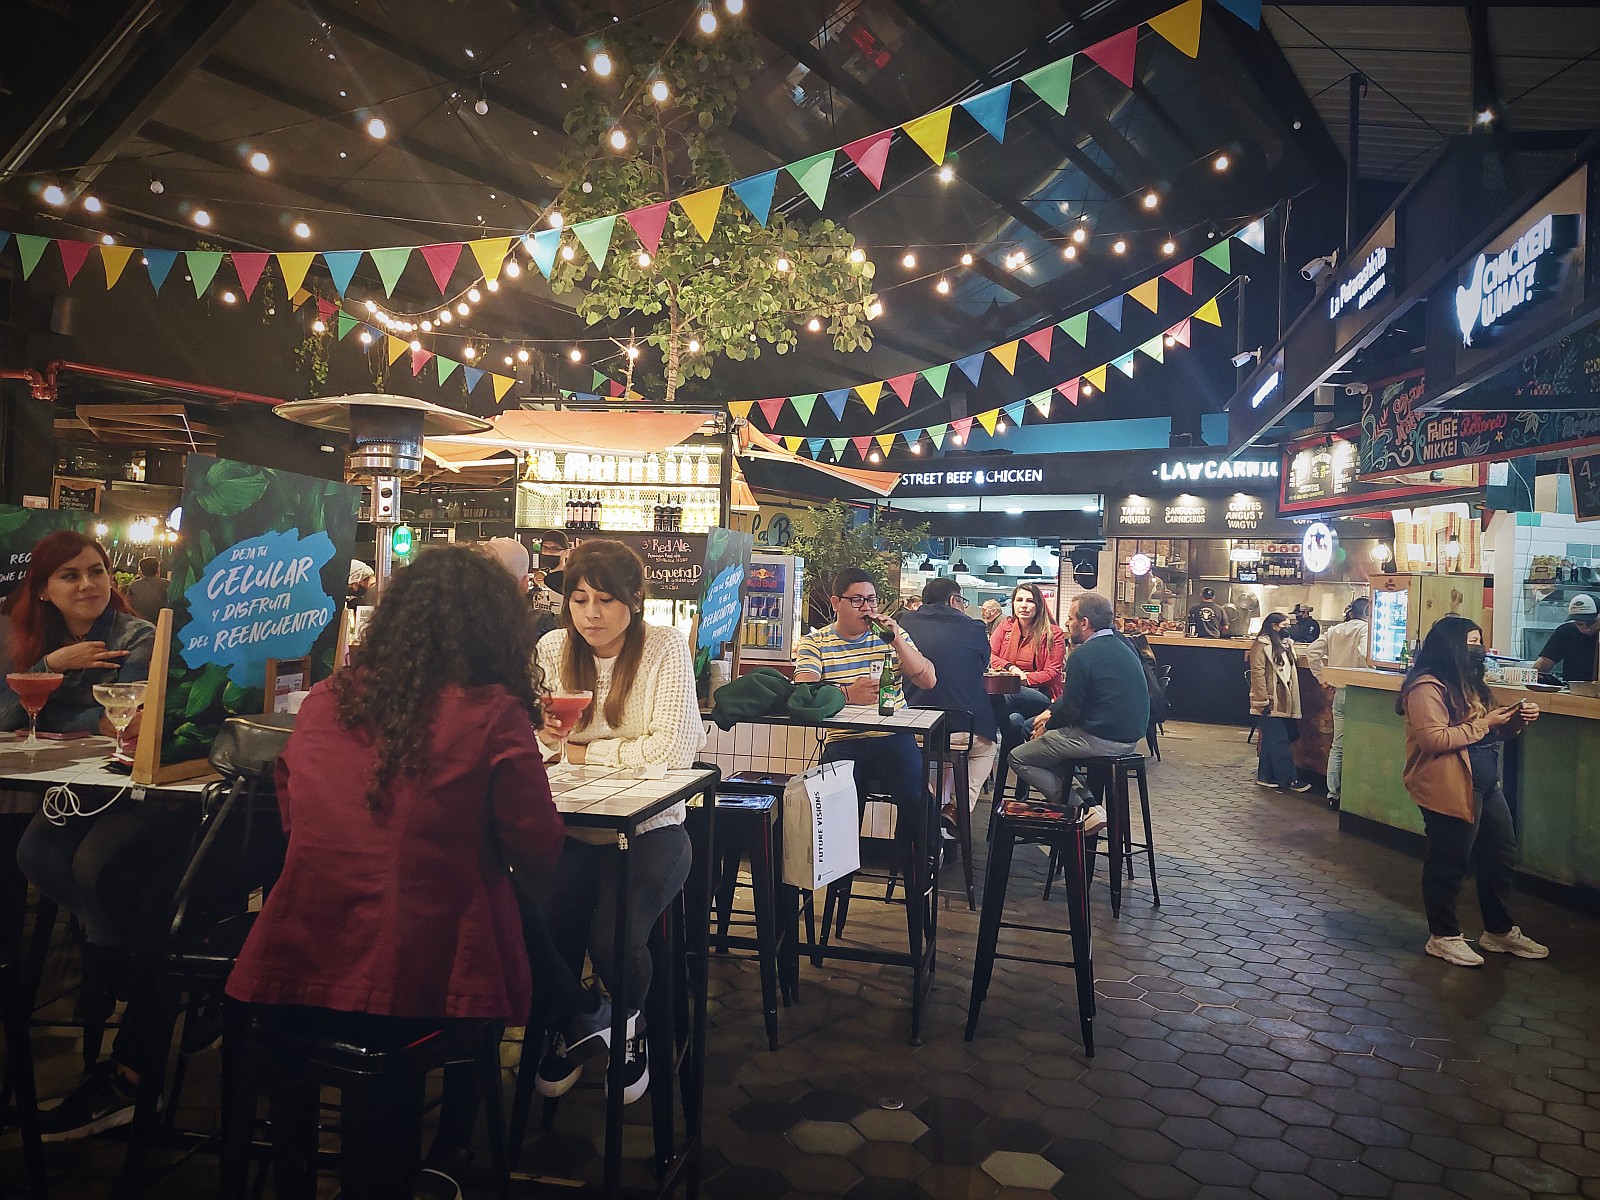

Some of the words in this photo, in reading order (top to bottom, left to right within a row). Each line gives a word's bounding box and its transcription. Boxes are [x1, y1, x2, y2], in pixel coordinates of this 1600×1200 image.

[1483, 214, 1552, 294] CHICKEN
[1481, 261, 1536, 327] WHAT?
[1330, 296, 1339, 318] La
[1427, 417, 1458, 442] PAICHE
[1423, 439, 1458, 460] NIKKEI
[901, 472, 944, 486] STREET
[946, 471, 972, 484] BEEF
[975, 470, 984, 484] &
[986, 469, 1043, 483] CHICKEN
[1160, 461, 1187, 481] LA
[1580, 460, 1591, 480] 4
[1119, 515, 1151, 524] PIQUEOS
[1121, 506, 1145, 516] TAPAS
[1145, 506, 1152, 515] Y
[1164, 515, 1206, 524] CARNICEROS
[1225, 511, 1256, 520] ANGUS
[1257, 511, 1264, 520] Y
[1227, 520, 1257, 529] WAGYU
[230, 548, 256, 562] DEJA
[257, 545, 269, 558] TU
[653, 538, 672, 553] Red
[207, 556, 314, 600] CELULAR
[644, 565, 692, 582] Cusqueña
[746, 579, 761, 588] Red
[762, 580, 778, 589] Bull
[221, 592, 291, 622] DISFRUTA
[187, 635, 209, 651] DEL
[213, 607, 328, 653] REENCUENTRO
[814, 790, 824, 826] VISIONS
